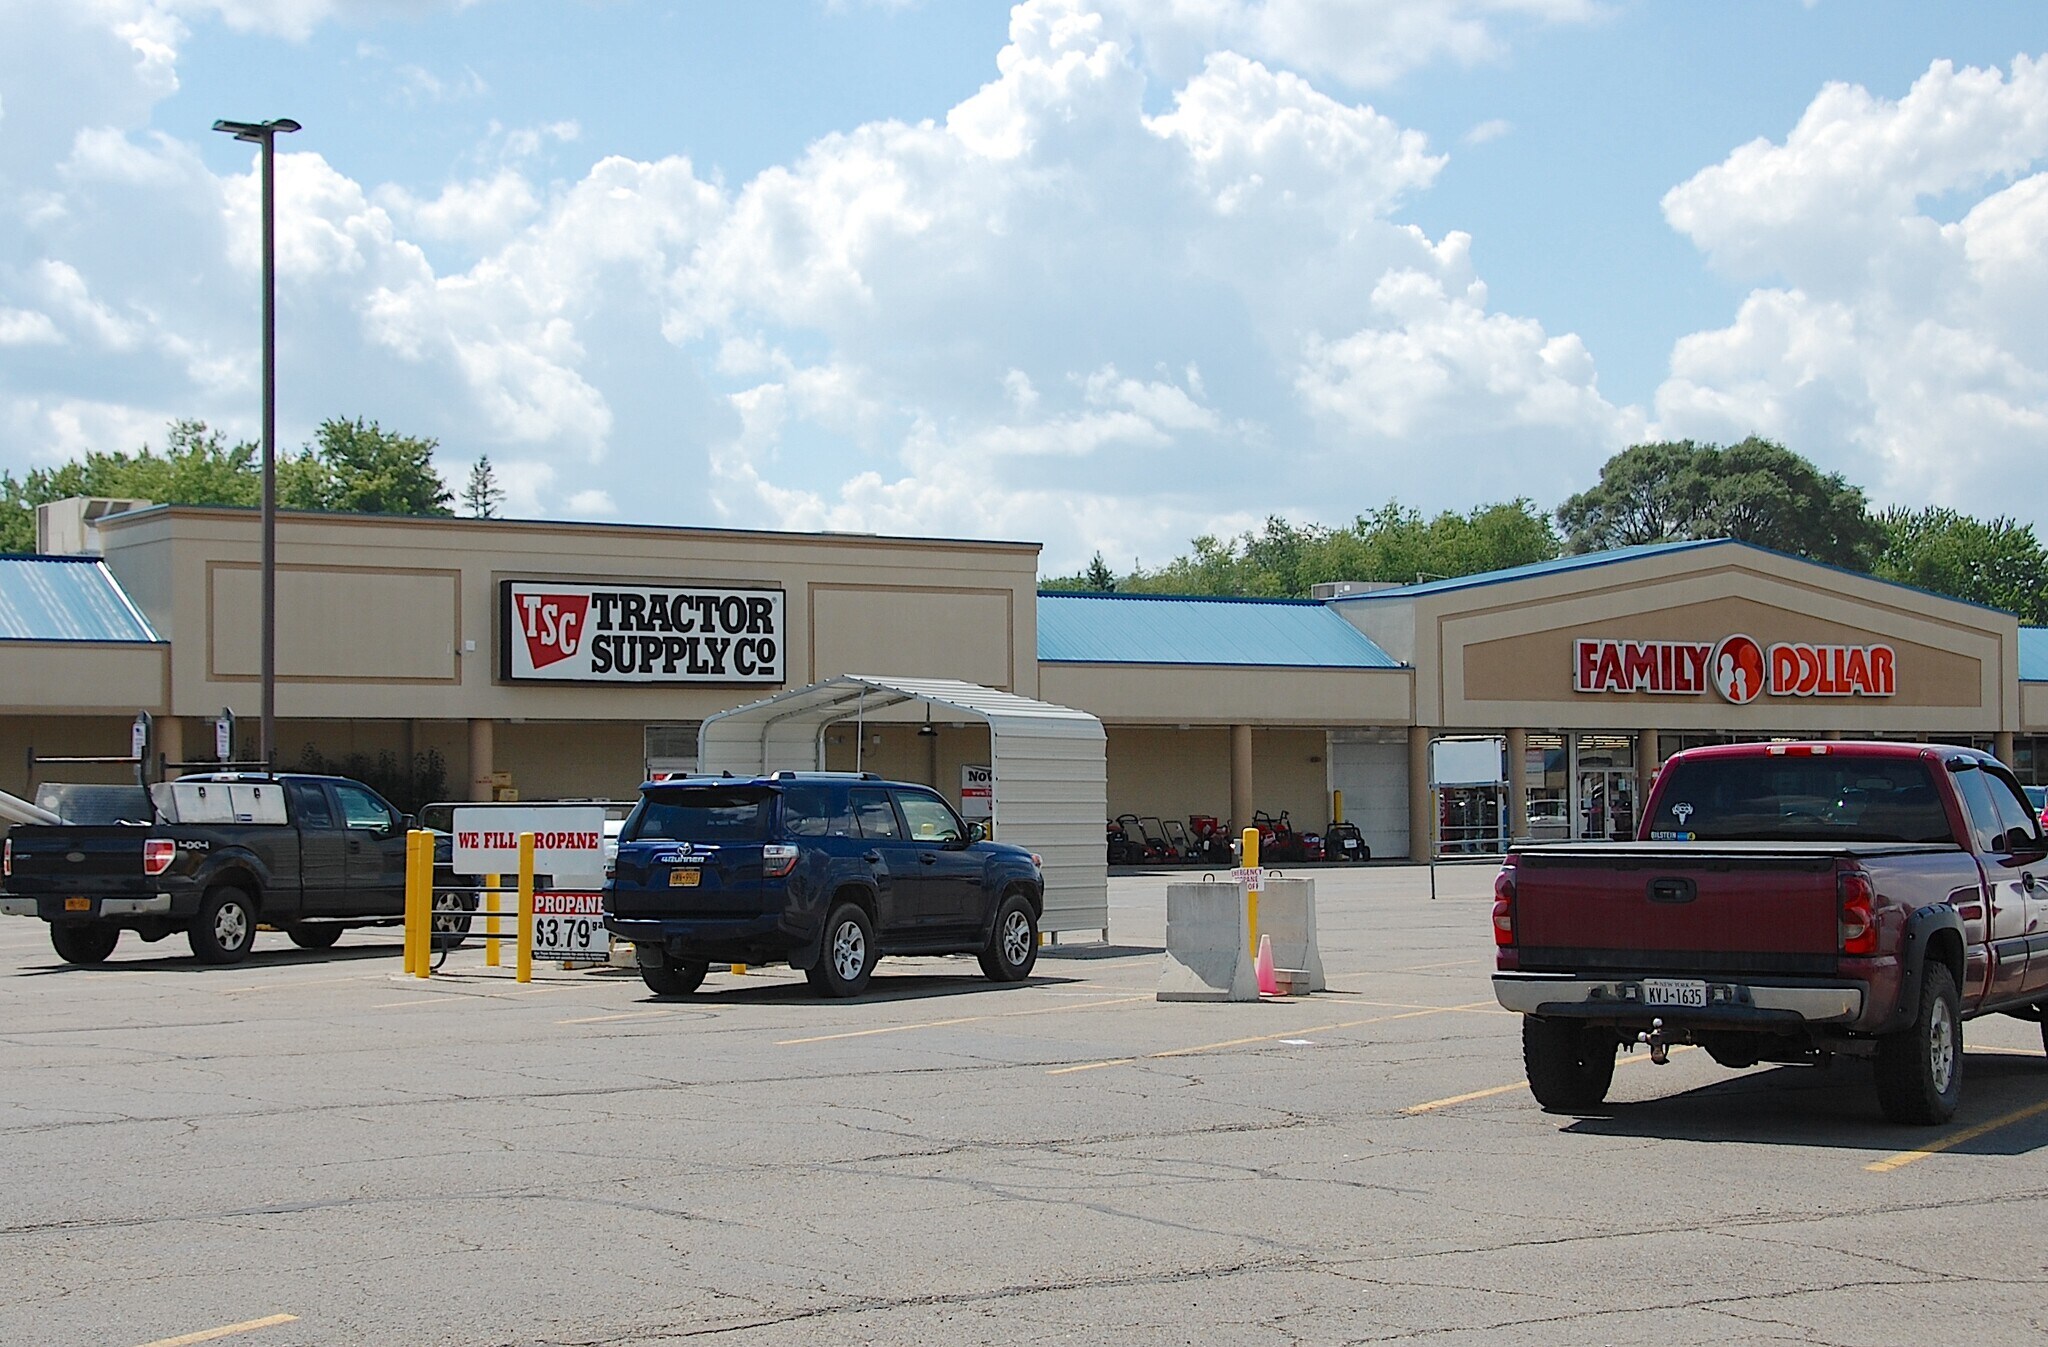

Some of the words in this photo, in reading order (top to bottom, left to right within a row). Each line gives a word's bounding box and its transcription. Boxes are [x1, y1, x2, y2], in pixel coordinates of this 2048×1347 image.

[523, 595, 577, 655] TSC
[592, 592, 774, 634] TRACTOR
[591, 634, 731, 675] SUPPLY
[1579, 642, 1714, 692] FAMILY
[1772, 645, 1893, 693] DOLLAR
[458, 832, 479, 849] WE
[484, 832, 517, 849] FILL
[533, 832, 599, 849] ROPANE
[1247, 883, 1259, 891] OFF
[536, 917, 590, 948] $3.79
[592, 921, 604, 931] ga
